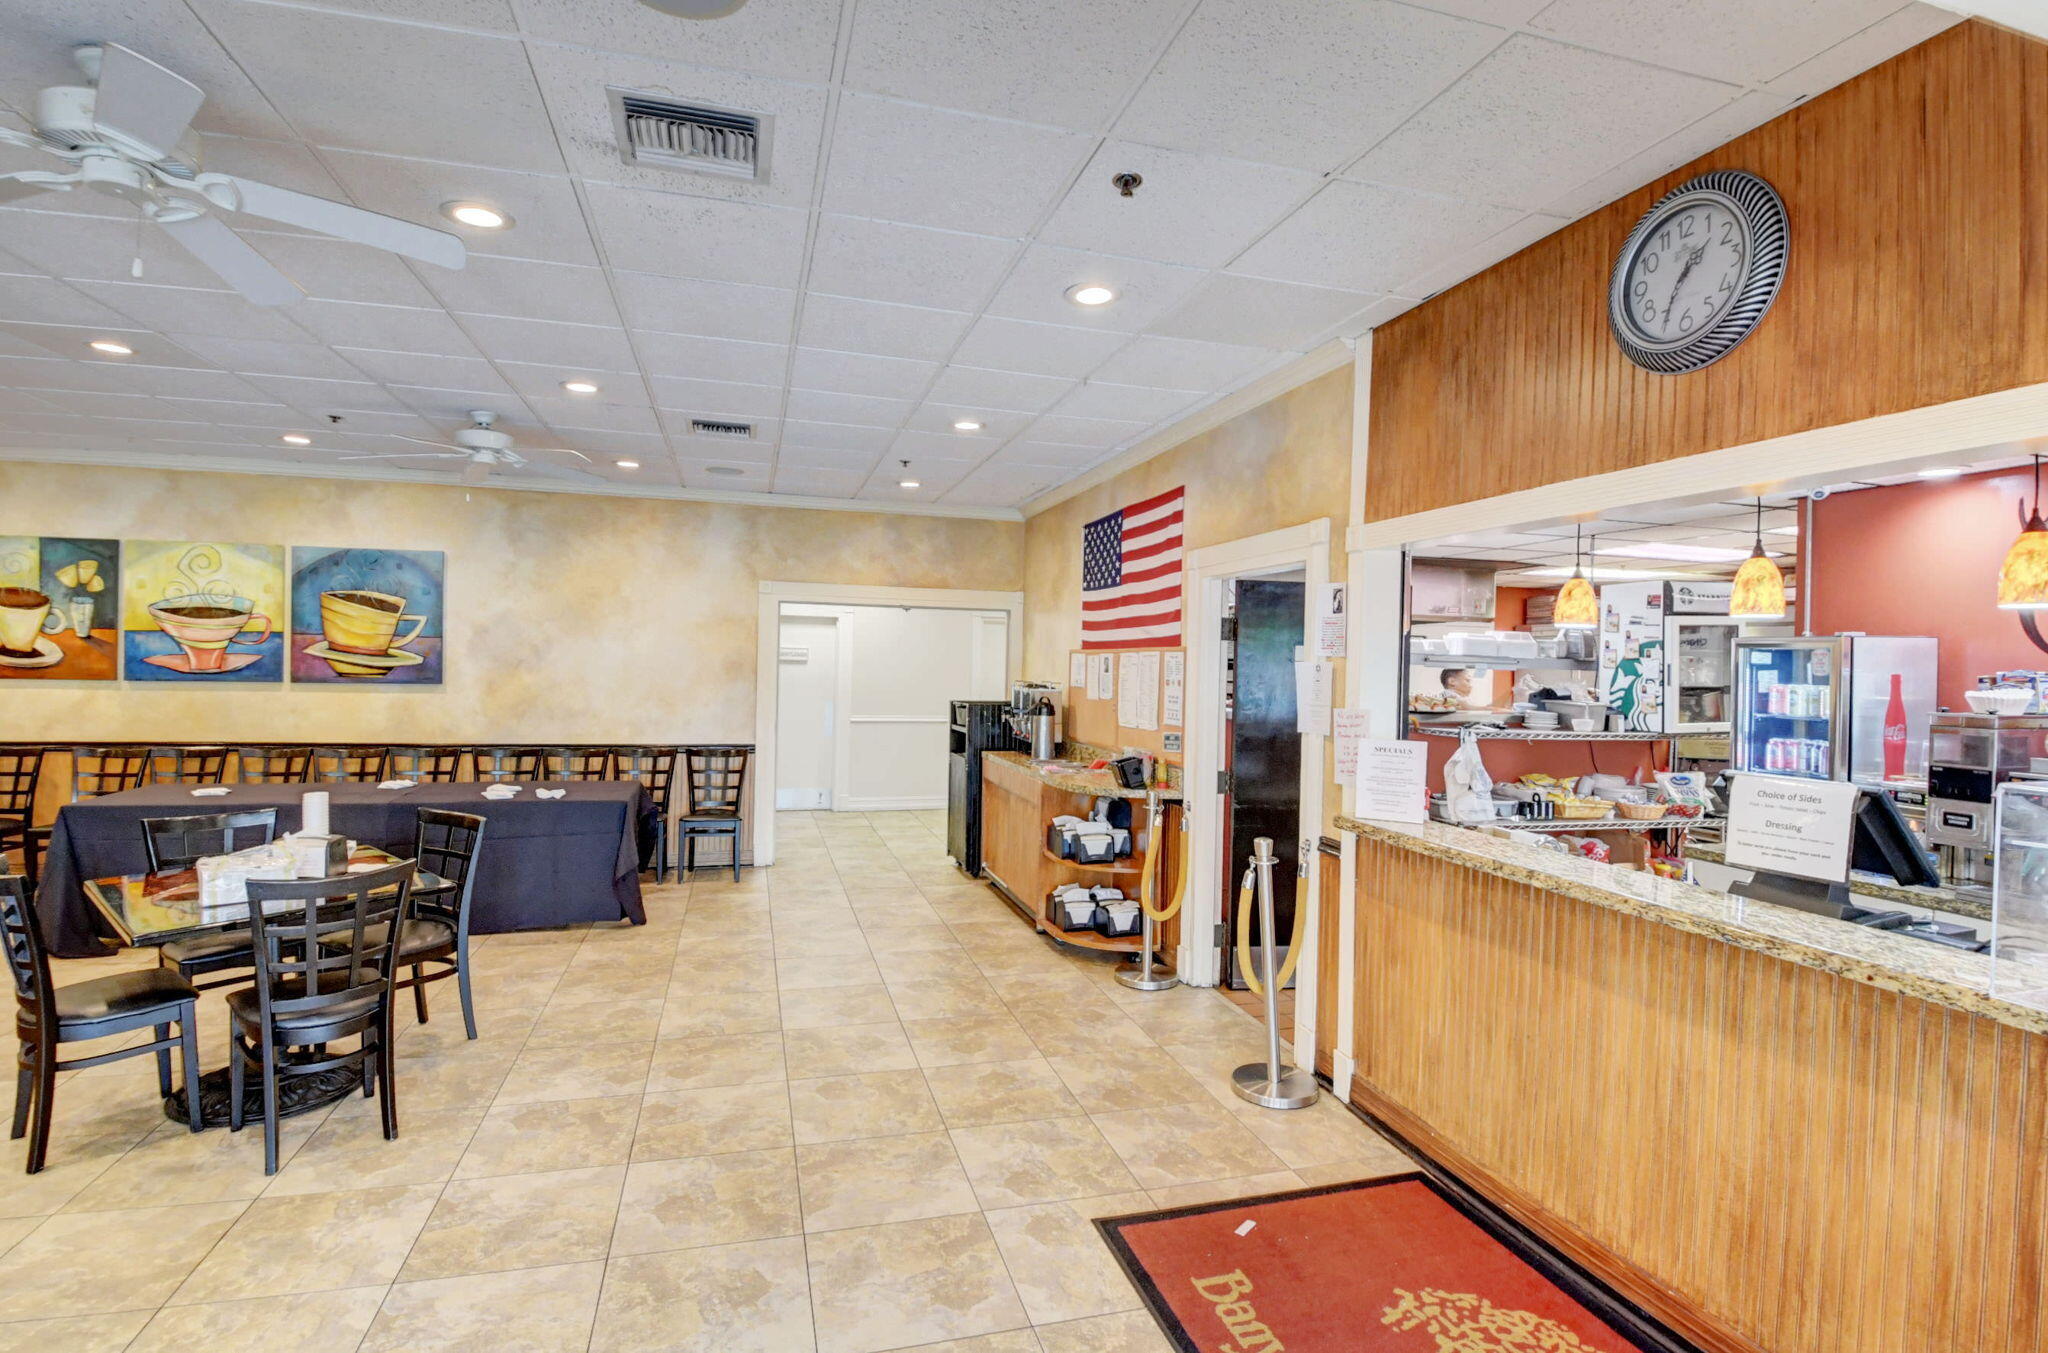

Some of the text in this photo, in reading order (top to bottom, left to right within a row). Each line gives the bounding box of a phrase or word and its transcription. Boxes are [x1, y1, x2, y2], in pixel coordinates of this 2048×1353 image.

[1677, 214, 1695, 240] 12
[1704, 212, 1712, 233] 1
[1719, 221, 1733, 246] 2
[1659, 229, 1671, 252] 11
[1641, 252, 1659, 276] 10
[1730, 243, 1741, 268] 3
[1634, 280, 1648, 304] 9
[1718, 272, 1733, 293] 4
[1642, 299, 1656, 323] 8
[1703, 295, 1715, 319] 5
[1679, 307, 1693, 332] 6
[1374, 746, 1413, 755] SPECIALS
[1757, 790, 1823, 804] Choice of Sides
[1765, 820, 1803, 833] Dressing
